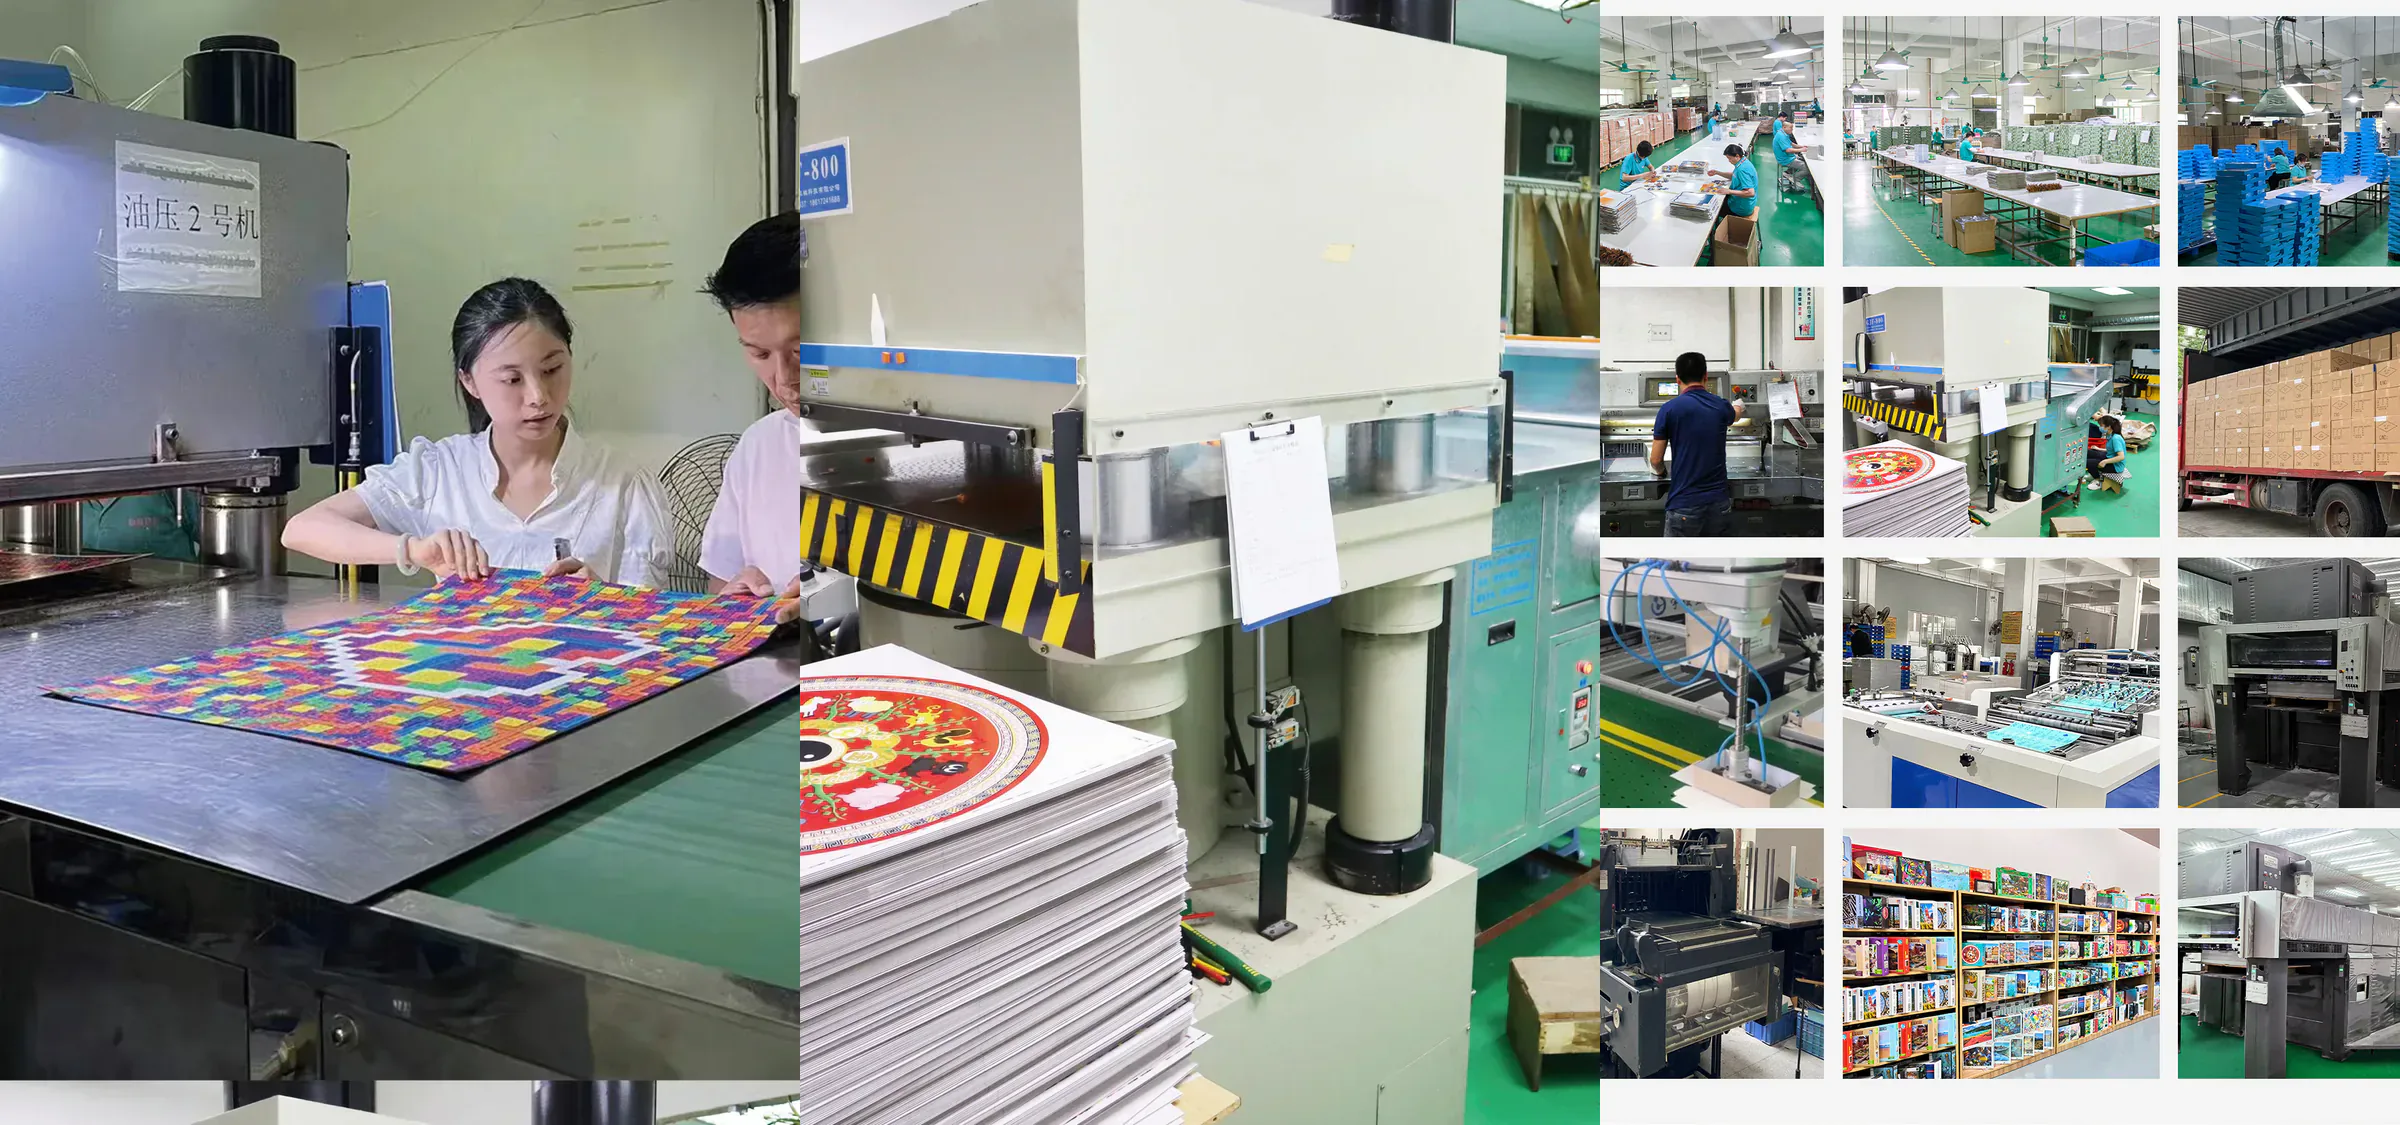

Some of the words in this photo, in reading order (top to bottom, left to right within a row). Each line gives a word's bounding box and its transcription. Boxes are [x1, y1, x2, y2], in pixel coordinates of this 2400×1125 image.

[800, 154, 839, 180] -800
[123, 194, 259, 239] 油压2号机
